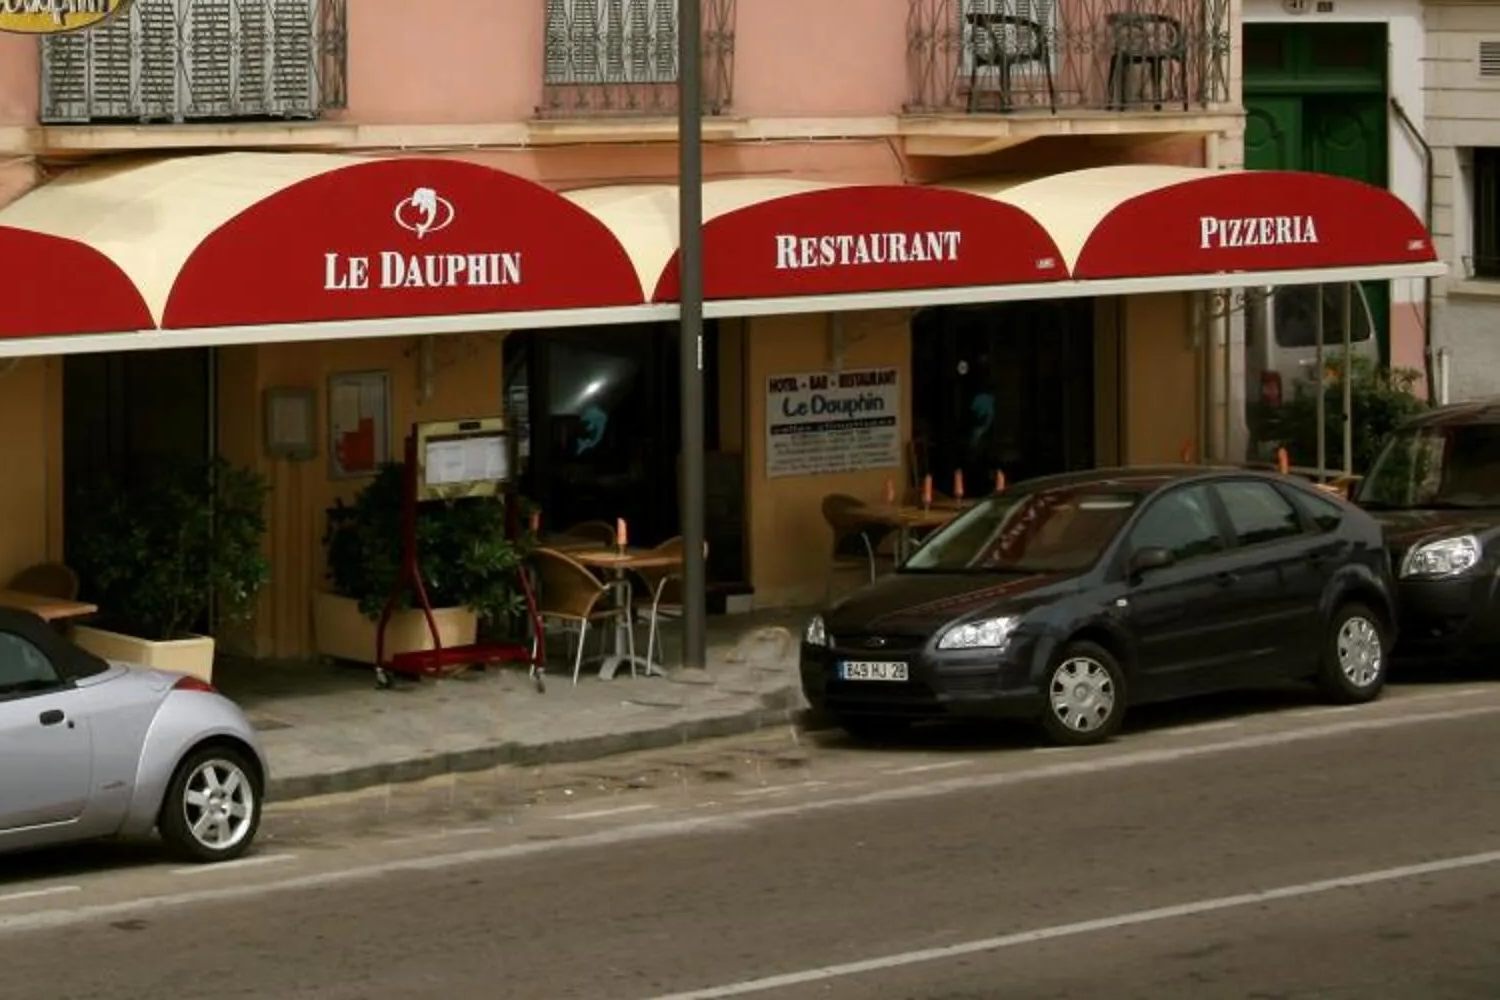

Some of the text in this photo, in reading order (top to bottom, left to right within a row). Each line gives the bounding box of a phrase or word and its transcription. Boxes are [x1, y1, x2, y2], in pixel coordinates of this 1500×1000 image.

[775, 231, 961, 269] RESTAURANT
[1199, 215, 1319, 249] PIZZERIA
[324, 251, 521, 290] LE DAUPHIN
[782, 392, 884, 417] Le Dauphin
